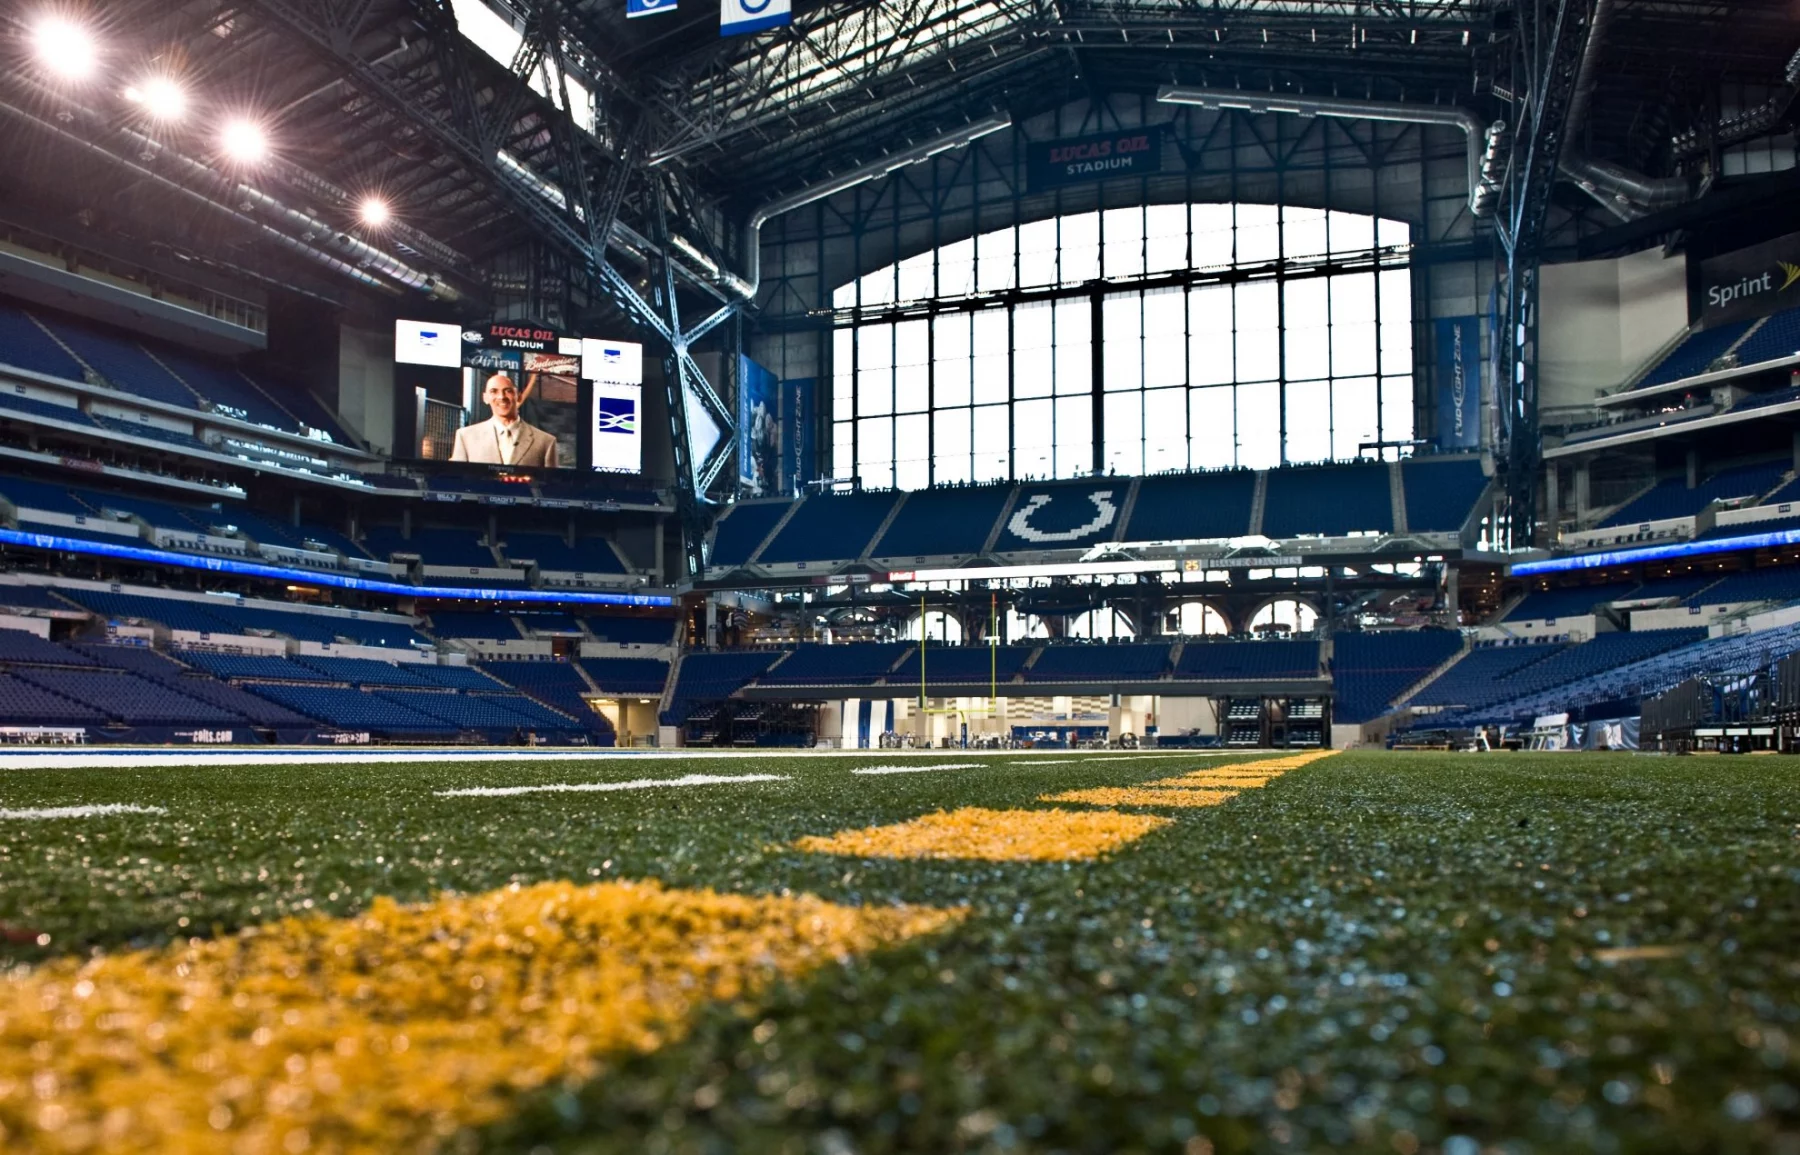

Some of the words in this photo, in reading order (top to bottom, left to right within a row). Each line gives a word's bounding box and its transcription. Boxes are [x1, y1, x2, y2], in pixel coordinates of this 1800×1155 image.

[1050, 141, 1112, 163] LUCAS
[1116, 135, 1150, 154] OIL
[1066, 156, 1133, 175] STADIUM
[1708, 271, 1772, 308] Sprint
[490, 325, 531, 338] LUCAS
[533, 330, 555, 341] OIL
[501, 338, 544, 349] STADIUM
[525, 356, 578, 371] Budweiser
